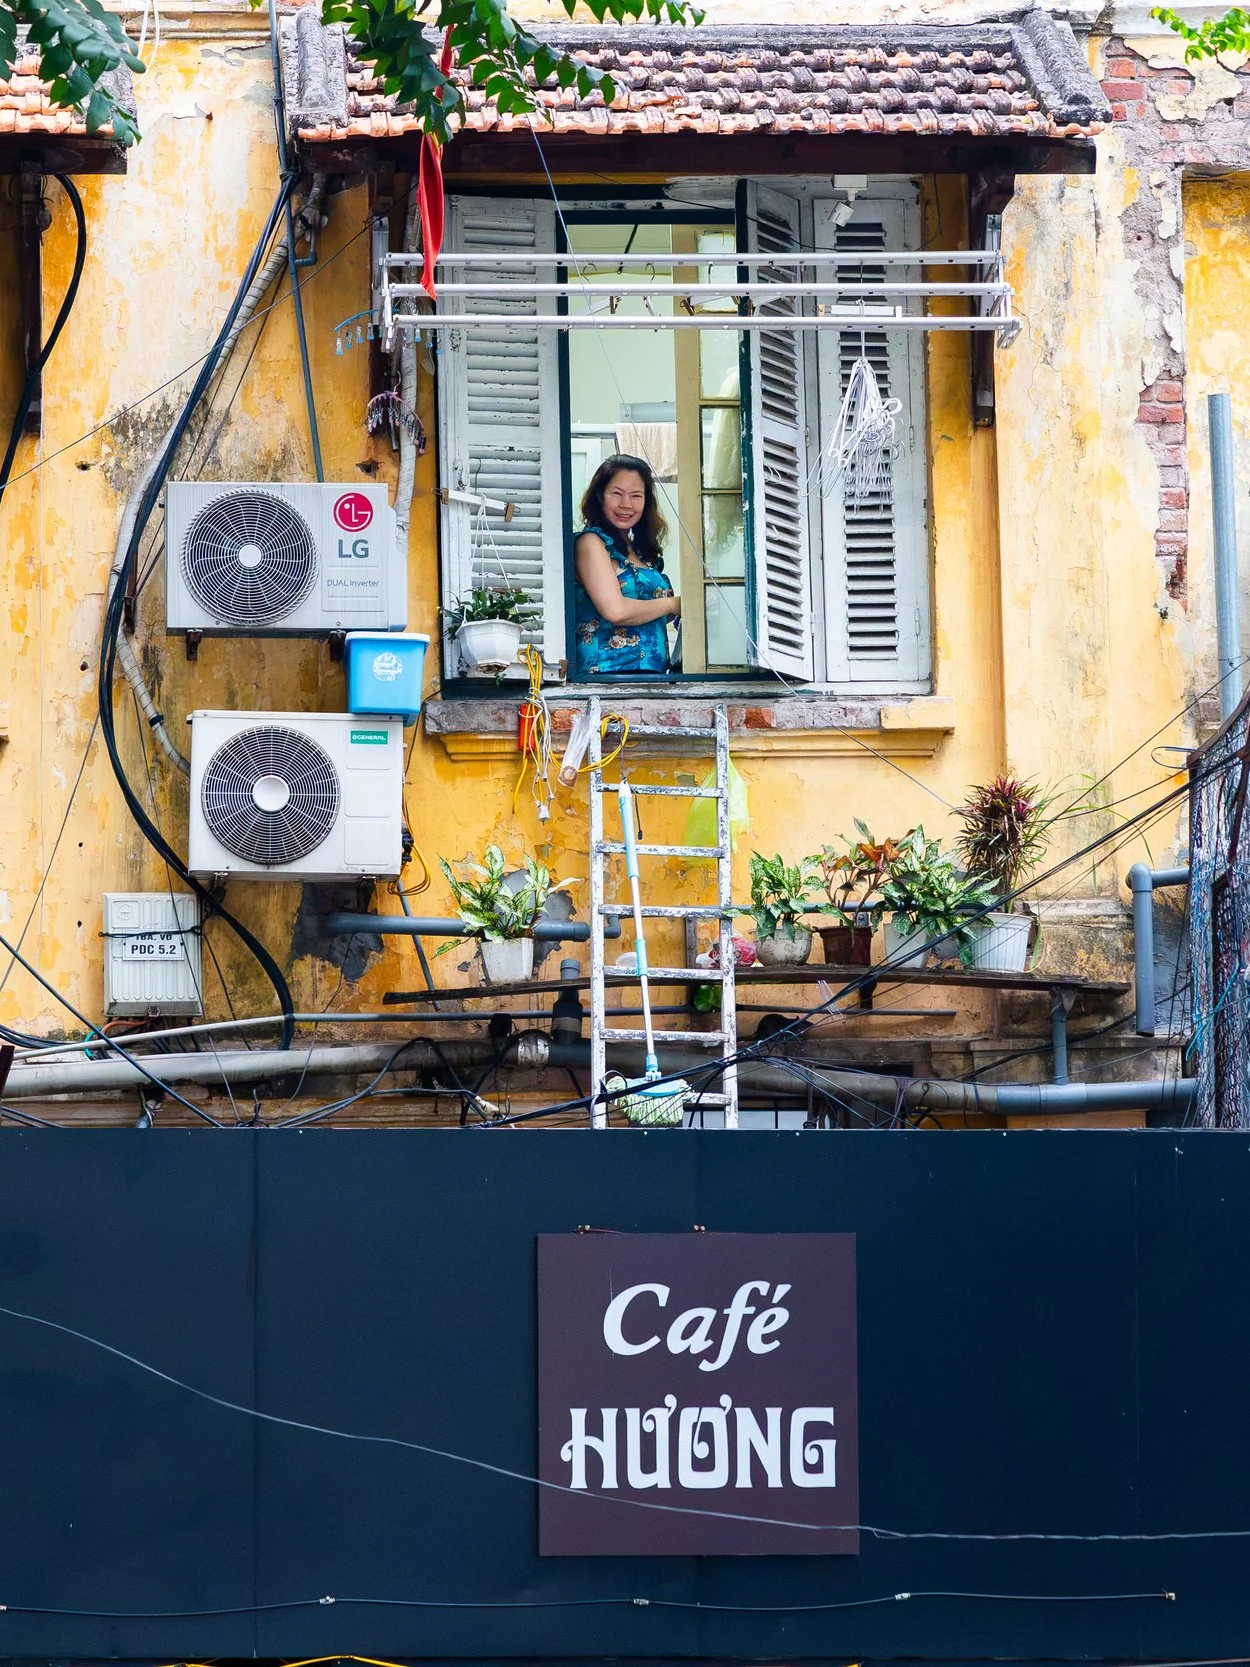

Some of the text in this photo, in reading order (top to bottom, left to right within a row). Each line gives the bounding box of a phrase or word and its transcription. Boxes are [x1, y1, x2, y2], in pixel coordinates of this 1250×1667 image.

[338, 538, 369, 558] LG
[327, 579, 379, 587] DUAL Inverter
[131, 944, 176, 954] PDC 5.2
[603, 1280, 792, 1372] Café
[560, 1393, 837, 1489] HƯƠNG
